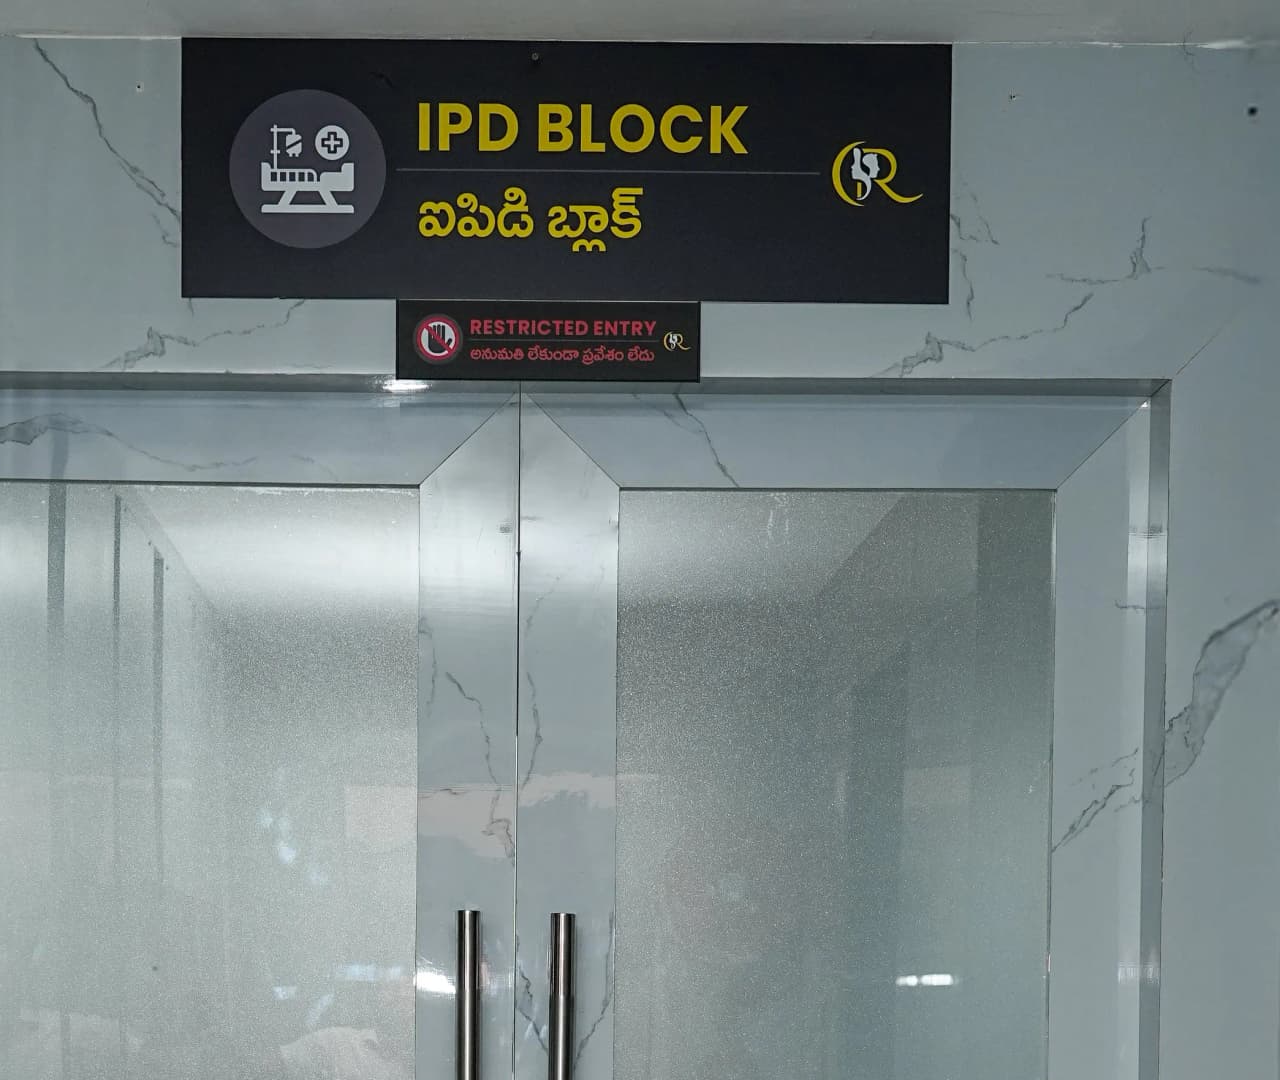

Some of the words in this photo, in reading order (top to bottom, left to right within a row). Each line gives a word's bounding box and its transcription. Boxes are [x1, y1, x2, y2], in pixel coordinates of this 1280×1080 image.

[418, 102, 519, 152] IPD
[537, 103, 749, 154] BLOCK
[418, 186, 534, 238] ఐపిడి
[547, 186, 644, 252] బ్లాక్
[469, 319, 589, 336] RESTRICTED
[593, 320, 657, 336] ENTRY
[470, 346, 525, 361] అనుమతి
[527, 344, 579, 361] లేకుండా
[581, 346, 624, 366] ప్రవేశం
[627, 346, 655, 362] లేదు
